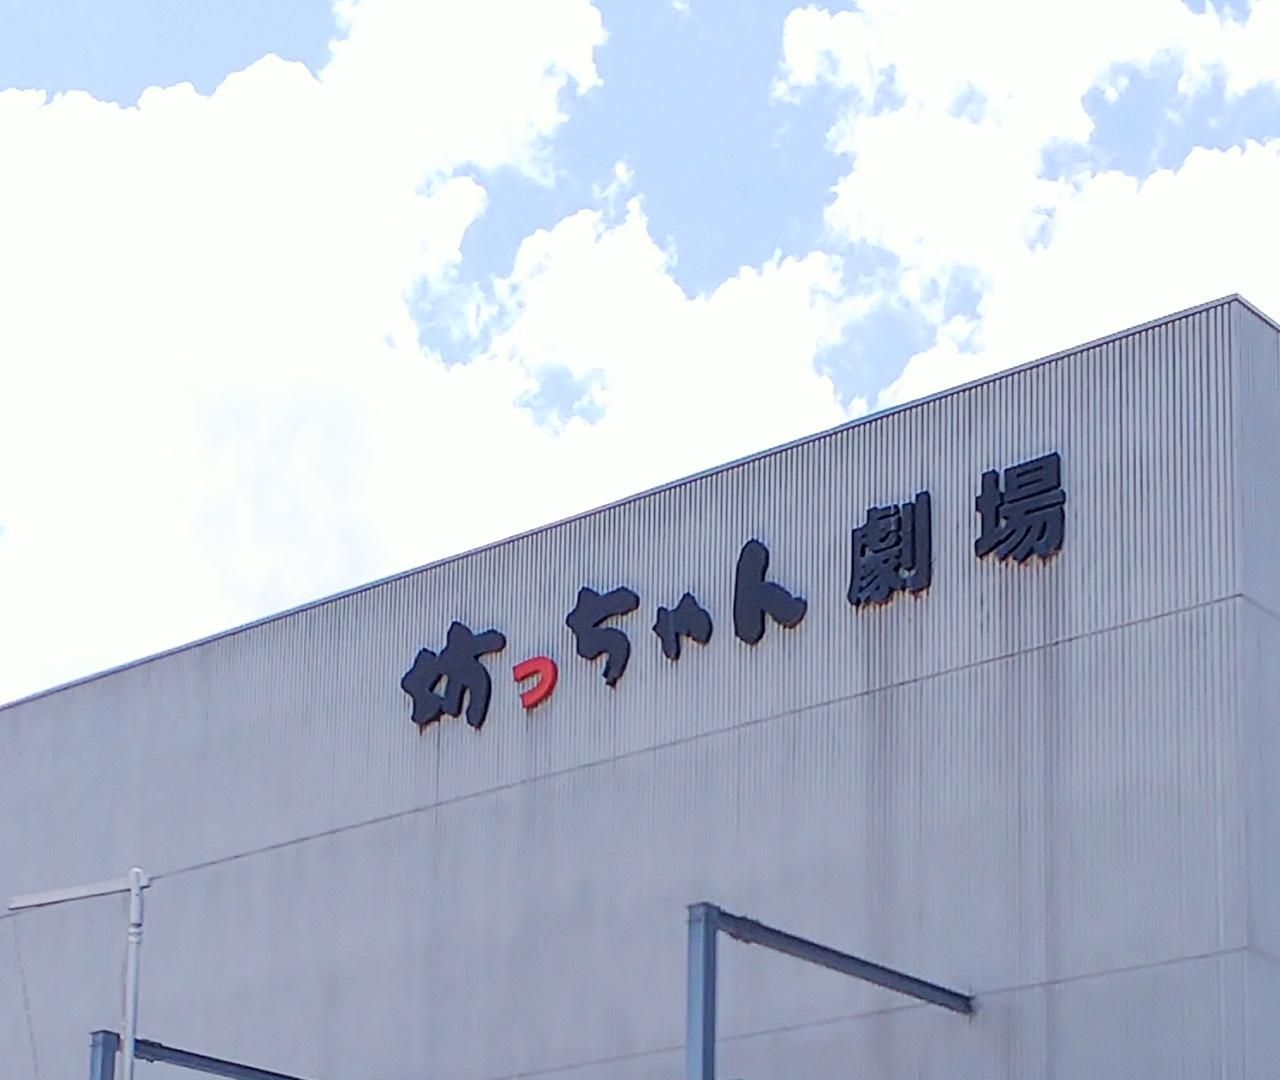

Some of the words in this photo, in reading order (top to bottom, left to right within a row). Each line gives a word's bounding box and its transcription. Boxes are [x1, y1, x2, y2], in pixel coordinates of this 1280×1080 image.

[401, 452, 1067, 730] 坊っちゃん劇場
